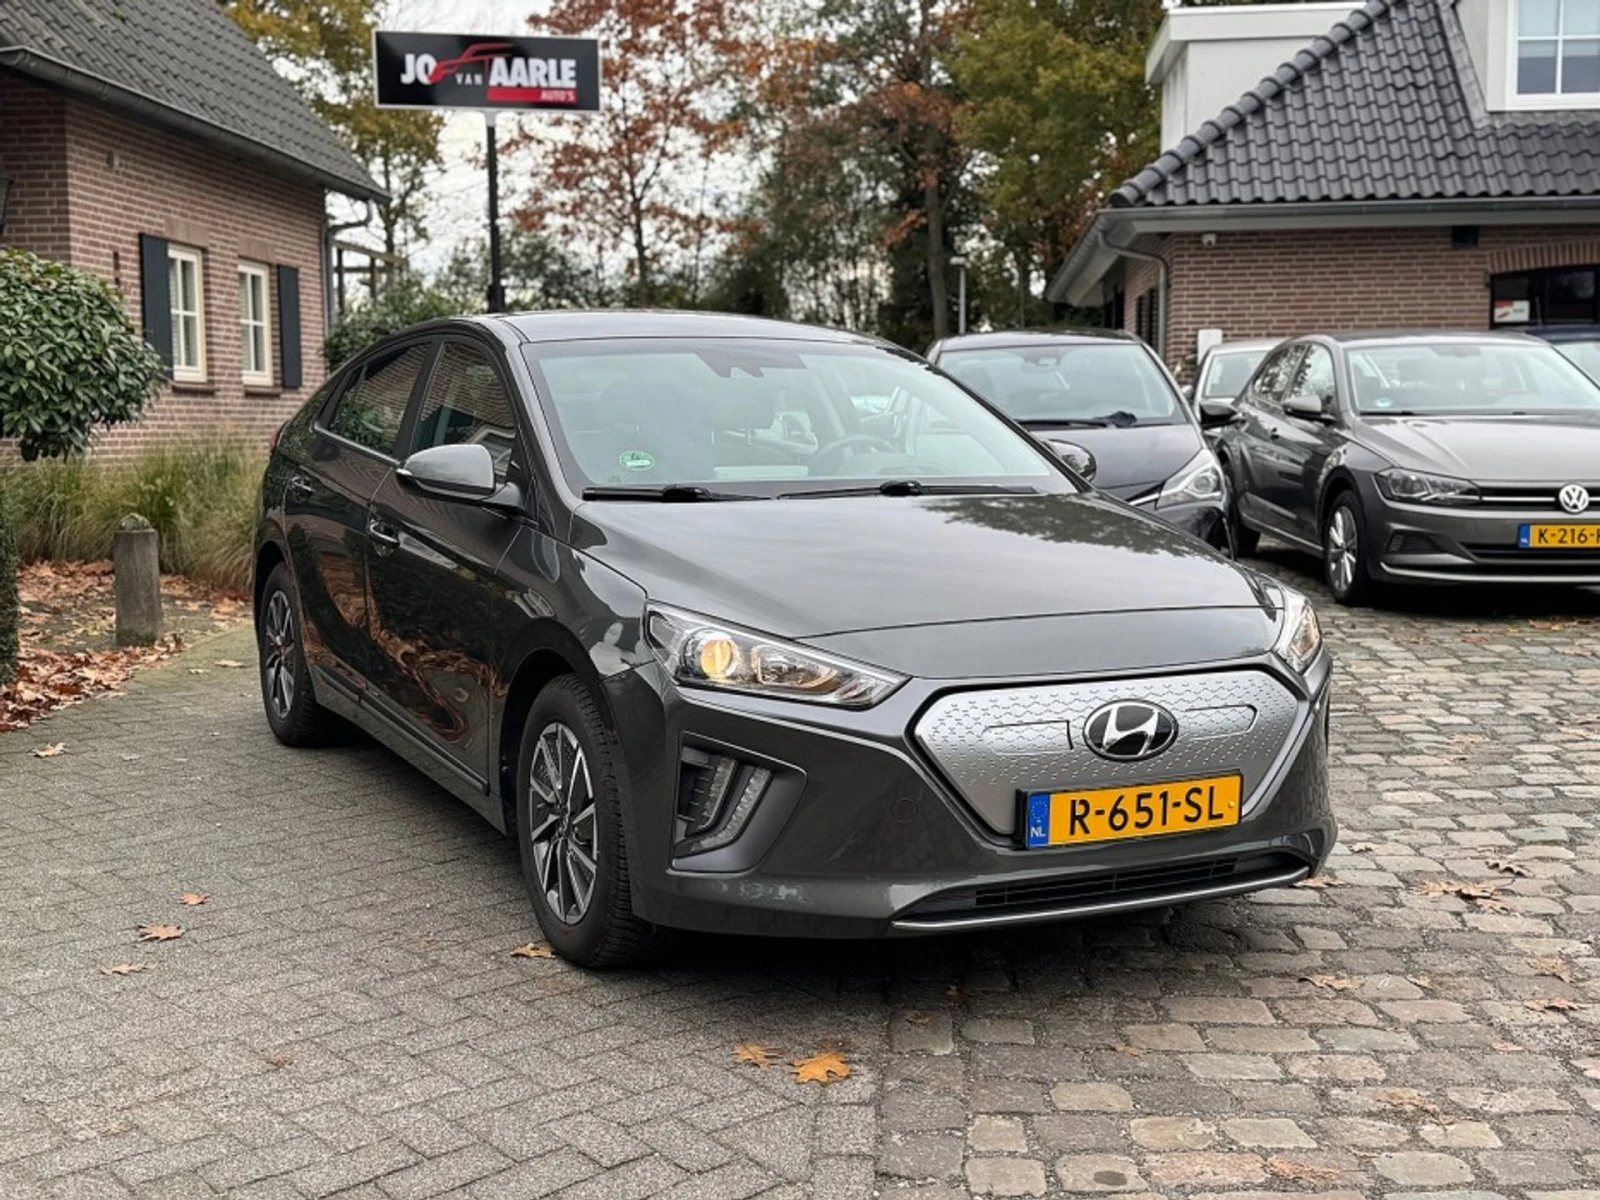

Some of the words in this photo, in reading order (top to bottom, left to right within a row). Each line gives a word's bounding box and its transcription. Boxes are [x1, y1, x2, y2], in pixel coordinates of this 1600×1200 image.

[401, 53, 437, 85] JO
[455, 73, 483, 85] VAN
[489, 57, 576, 88] AARLE
[1069, 786, 1224, 836] R-651-SL
[1030, 826, 1046, 838] NL
